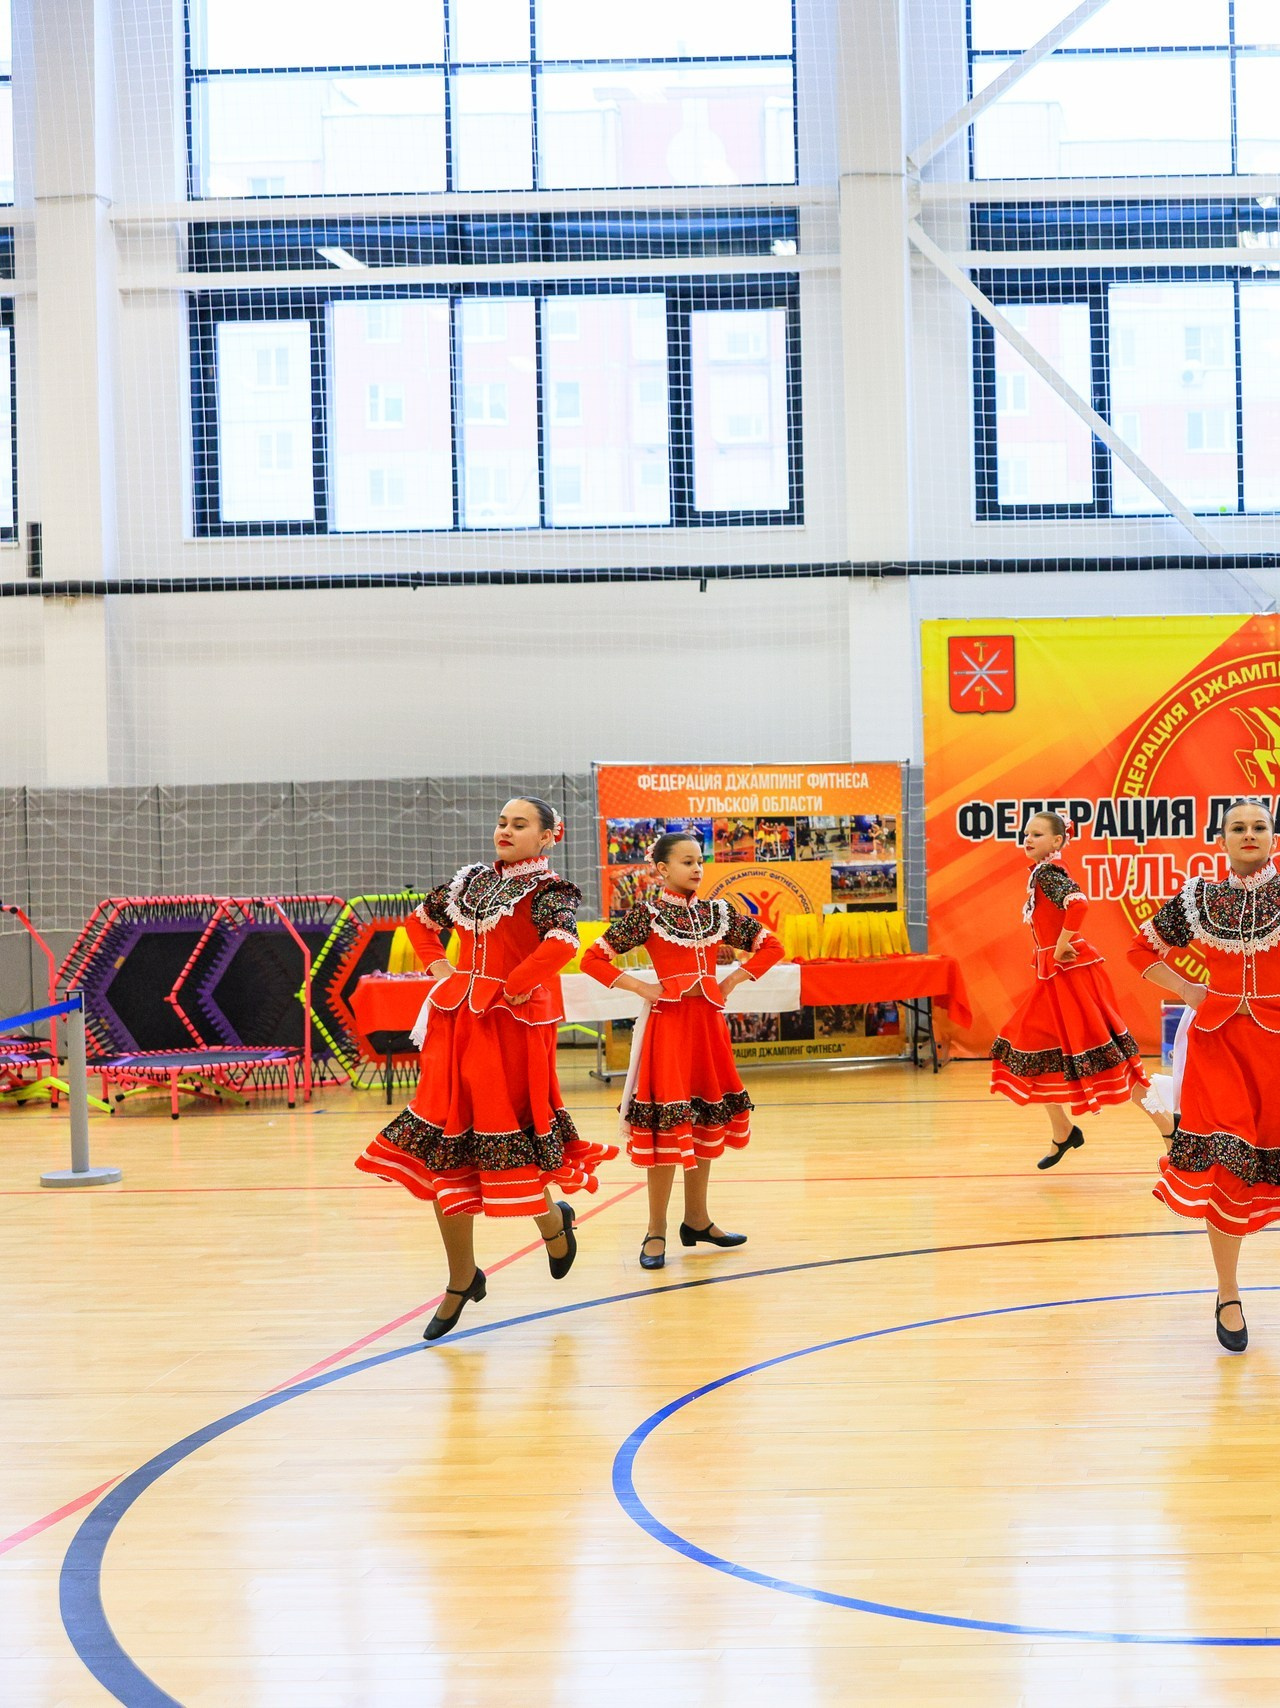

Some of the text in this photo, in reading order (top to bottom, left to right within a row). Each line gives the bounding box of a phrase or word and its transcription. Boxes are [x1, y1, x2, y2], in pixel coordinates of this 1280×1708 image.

[1123, 702, 1189, 797] ДЕРАЦИЯ
[637, 772, 869, 792] ФЕДЕРАЦИЯ ДЖАМПИНГ ФИТНЕСА
[688, 794, 823, 813] ТУЛЬСКОЙ ОБЛАСТИ
[725, 870, 811, 914] ДЖАМПИНГ ФИТНЕСА РОСС
[732, 1048, 757, 1058] РАЦИЯ
[758, 1045, 804, 1058] ДЖАМПИНГ
